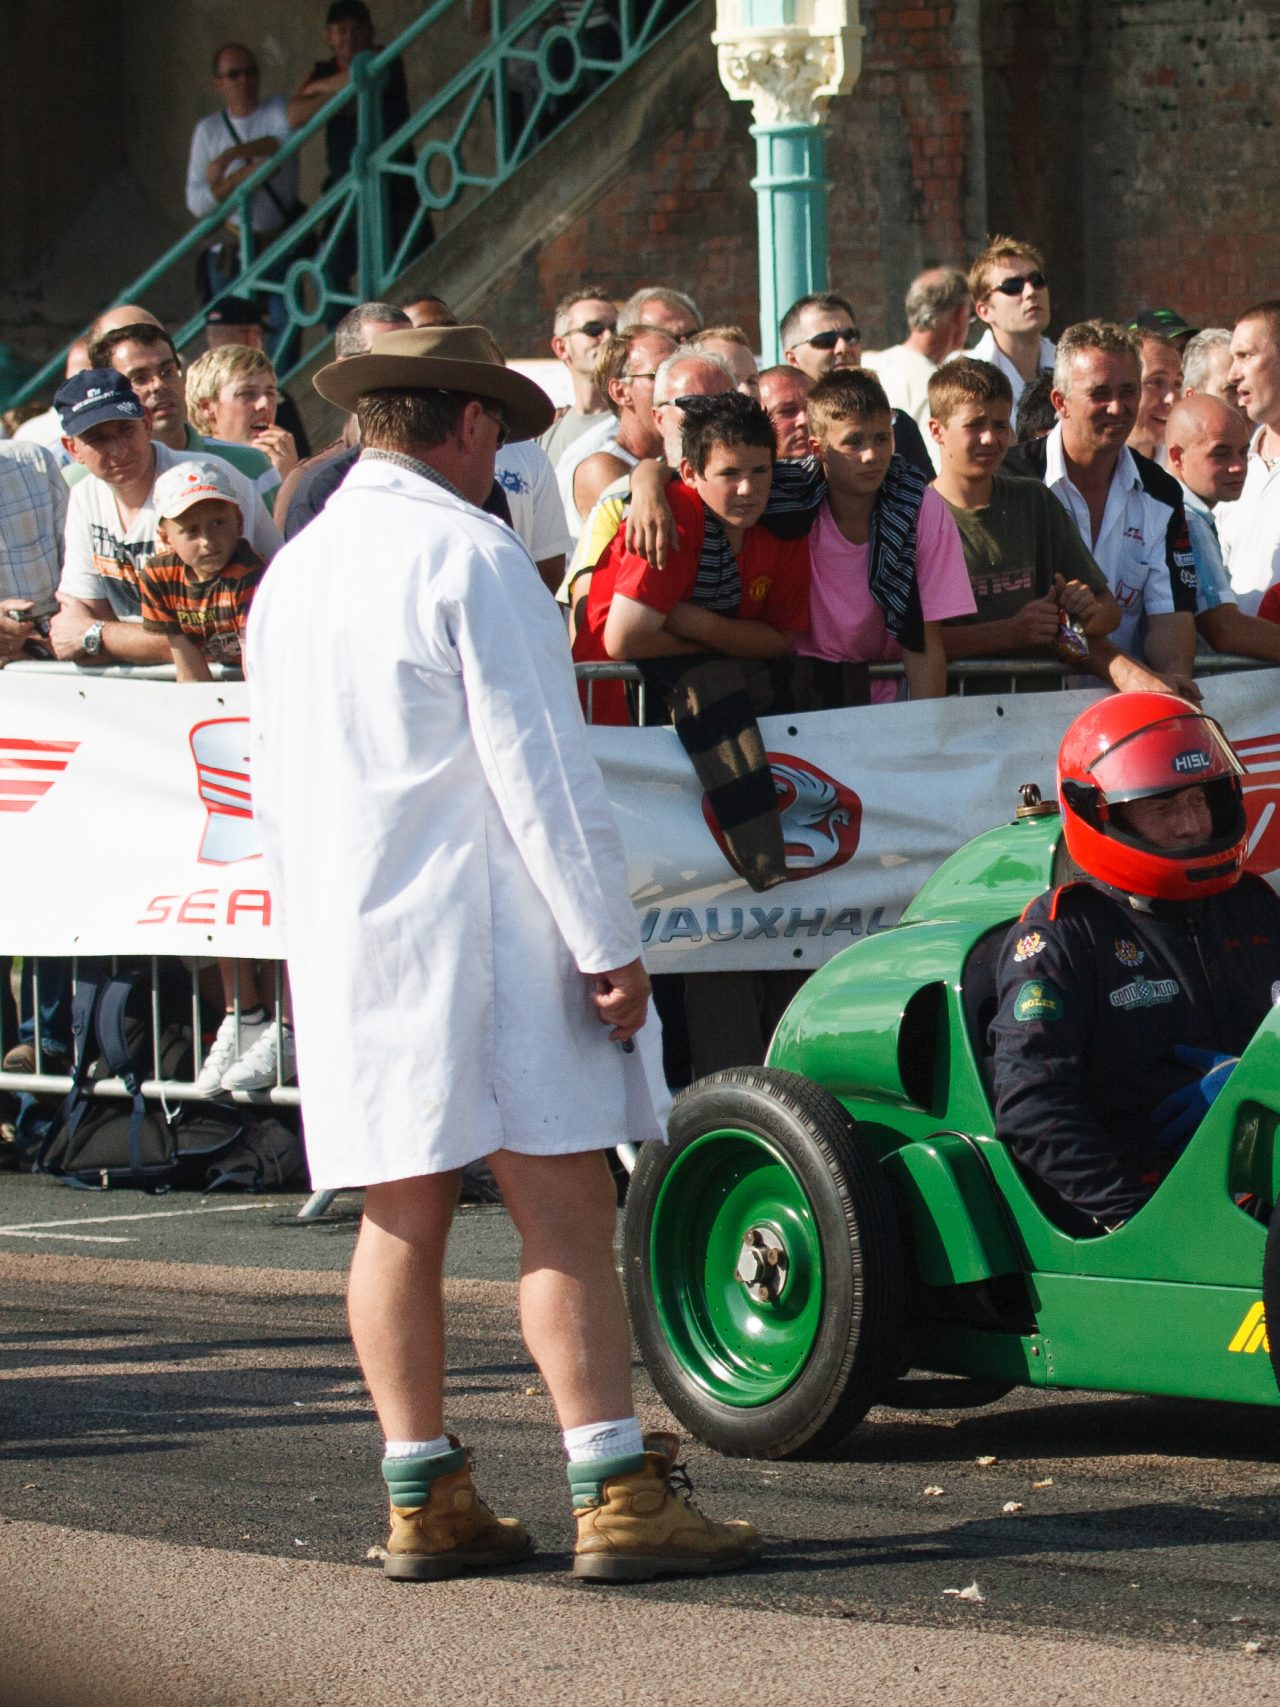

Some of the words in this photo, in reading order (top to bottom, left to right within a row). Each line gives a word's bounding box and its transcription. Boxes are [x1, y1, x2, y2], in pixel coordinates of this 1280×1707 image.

[1175, 753, 1210, 771] HISL
[136, 888, 272, 927] SEA
[640, 907, 903, 943] AUXHAL
[1020, 998, 1056, 1013] ROLEX
